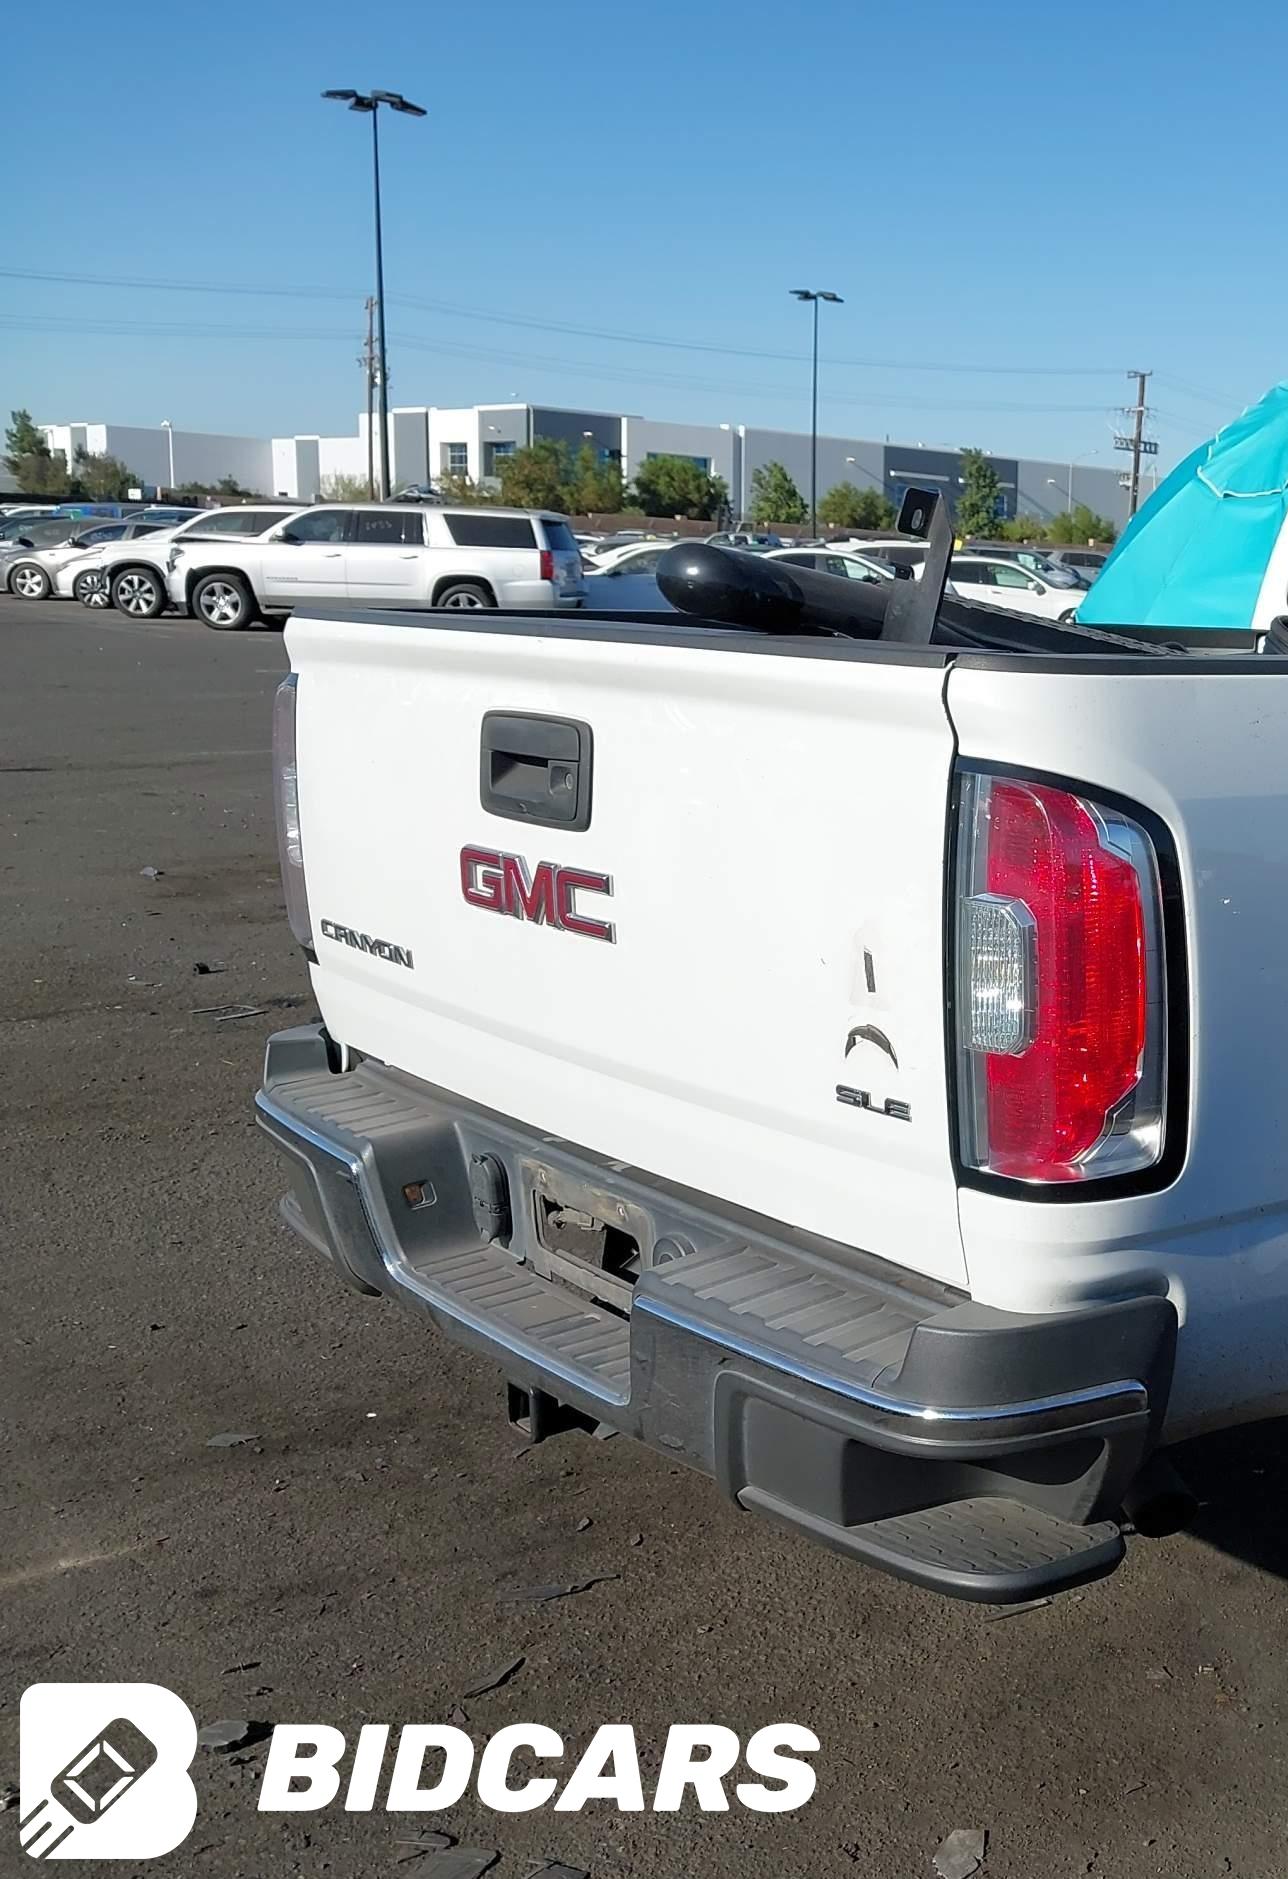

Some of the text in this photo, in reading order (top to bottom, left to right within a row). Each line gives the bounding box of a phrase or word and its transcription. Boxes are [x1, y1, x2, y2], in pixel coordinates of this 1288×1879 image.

[460, 843, 617, 944] GMC
[320, 918, 414, 970] CANYON
[836, 1084, 912, 1122] SLE
